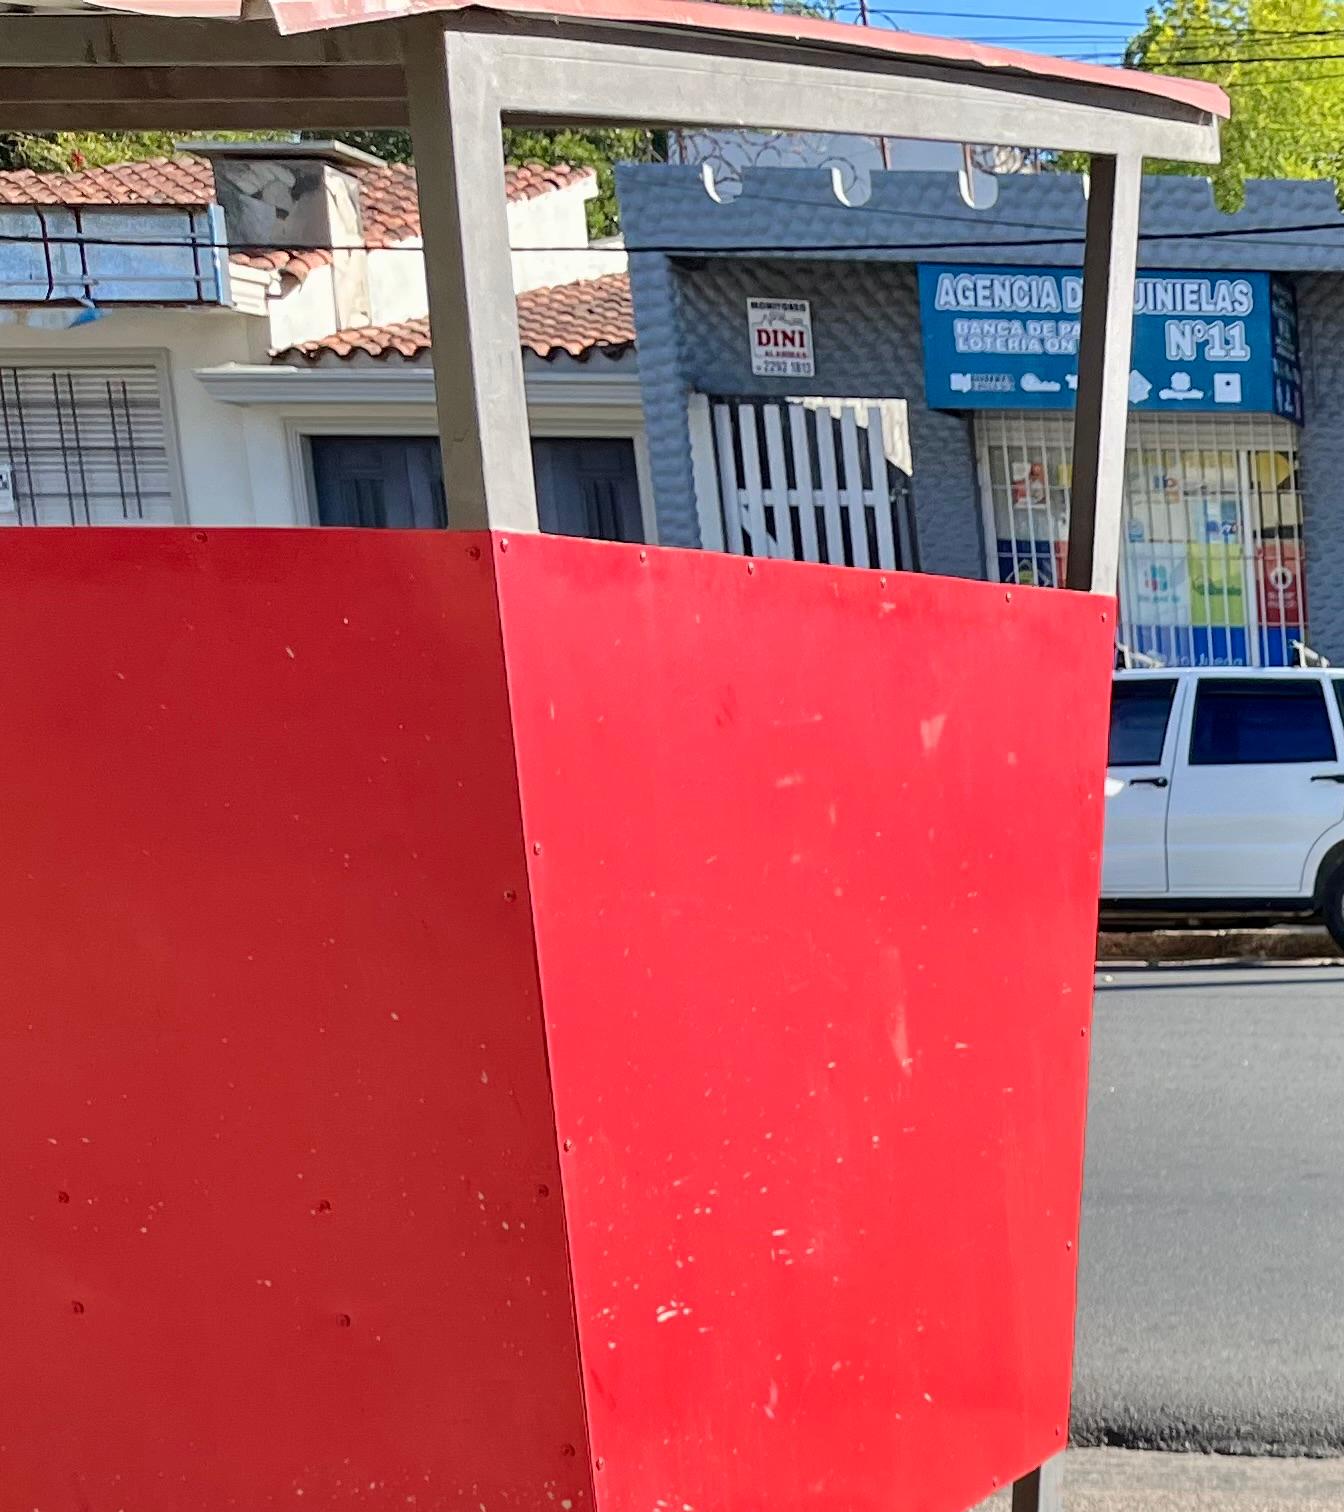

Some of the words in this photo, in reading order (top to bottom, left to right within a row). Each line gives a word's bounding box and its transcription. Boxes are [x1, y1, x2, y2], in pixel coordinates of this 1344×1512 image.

[935, 273, 1062, 312] AGENCIA
[1062, 276, 1083, 313] D
[1134, 279, 1252, 316] UINIELAS
[757, 329, 805, 348] DINI
[1027, 319, 1057, 338] DE
[1058, 320, 1081, 339] PA
